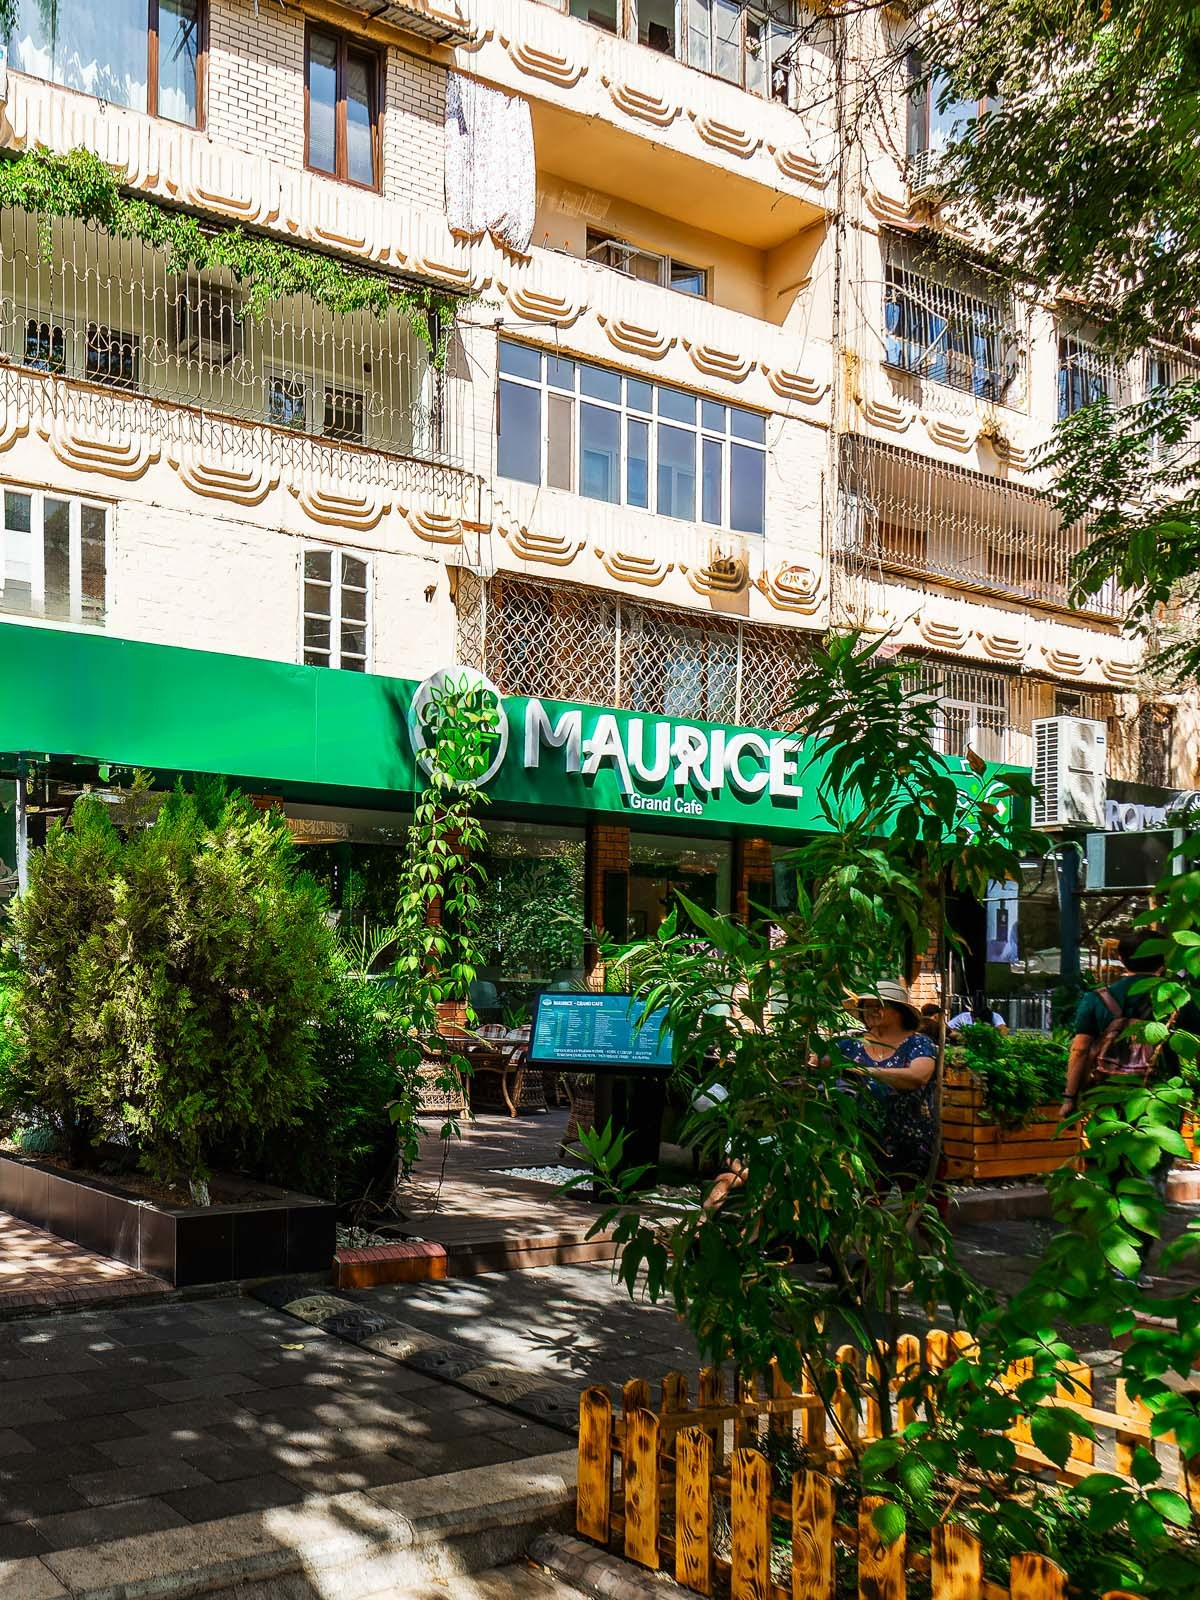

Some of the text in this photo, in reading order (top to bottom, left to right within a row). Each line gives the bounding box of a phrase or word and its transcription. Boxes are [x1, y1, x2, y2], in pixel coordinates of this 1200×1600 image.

[524, 697, 804, 798] MAURICE
[630, 793, 703, 815] Grand Cafe
